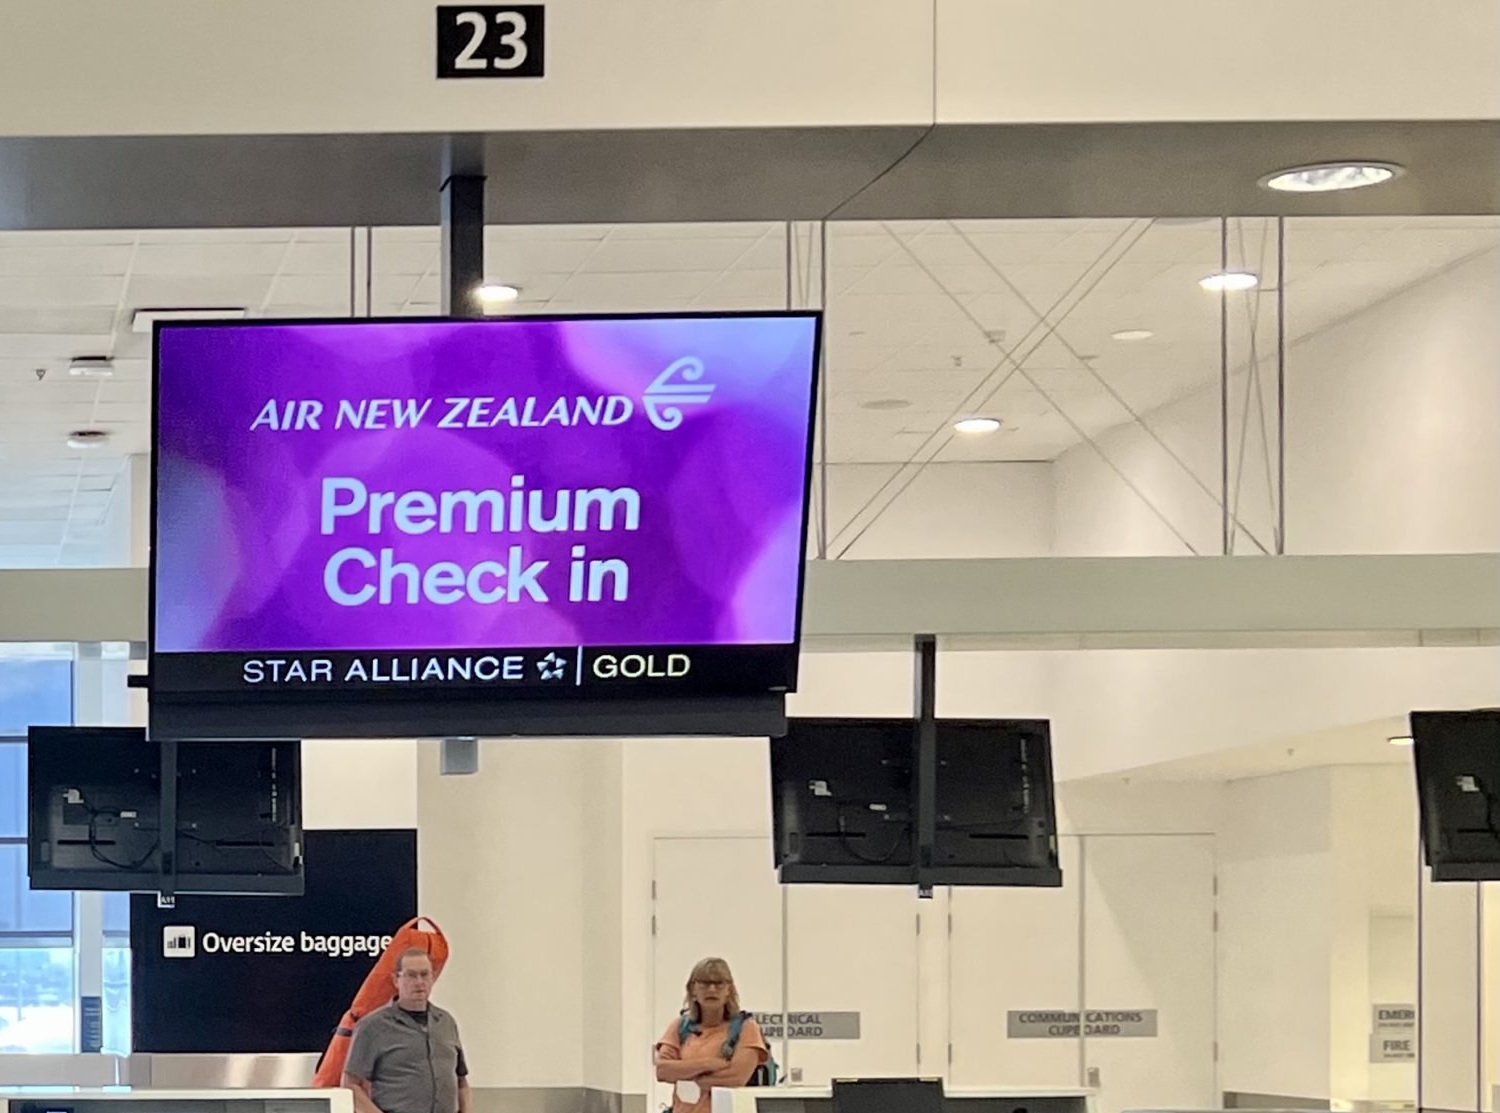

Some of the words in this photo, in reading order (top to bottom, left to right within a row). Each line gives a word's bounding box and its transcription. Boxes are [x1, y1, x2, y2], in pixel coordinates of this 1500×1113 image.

[454, 11, 527, 70] 23
[249, 399, 323, 431] AIR
[334, 399, 432, 431] NEW
[437, 396, 634, 429] ZEALAND
[320, 474, 641, 536] Premium
[323, 545, 550, 607] Check
[568, 545, 630, 602] in
[242, 658, 333, 684] STAR
[344, 655, 524, 683] ALLIANCE
[592, 653, 692, 679] GOLD
[202, 931, 295, 953] Oversize
[300, 931, 393, 957] baggage
[755, 1013, 822, 1025] LECTRICAL
[760, 1026, 823, 1038] UPBOARD
[1019, 1012, 1143, 1024] COMMUNCATIONS
